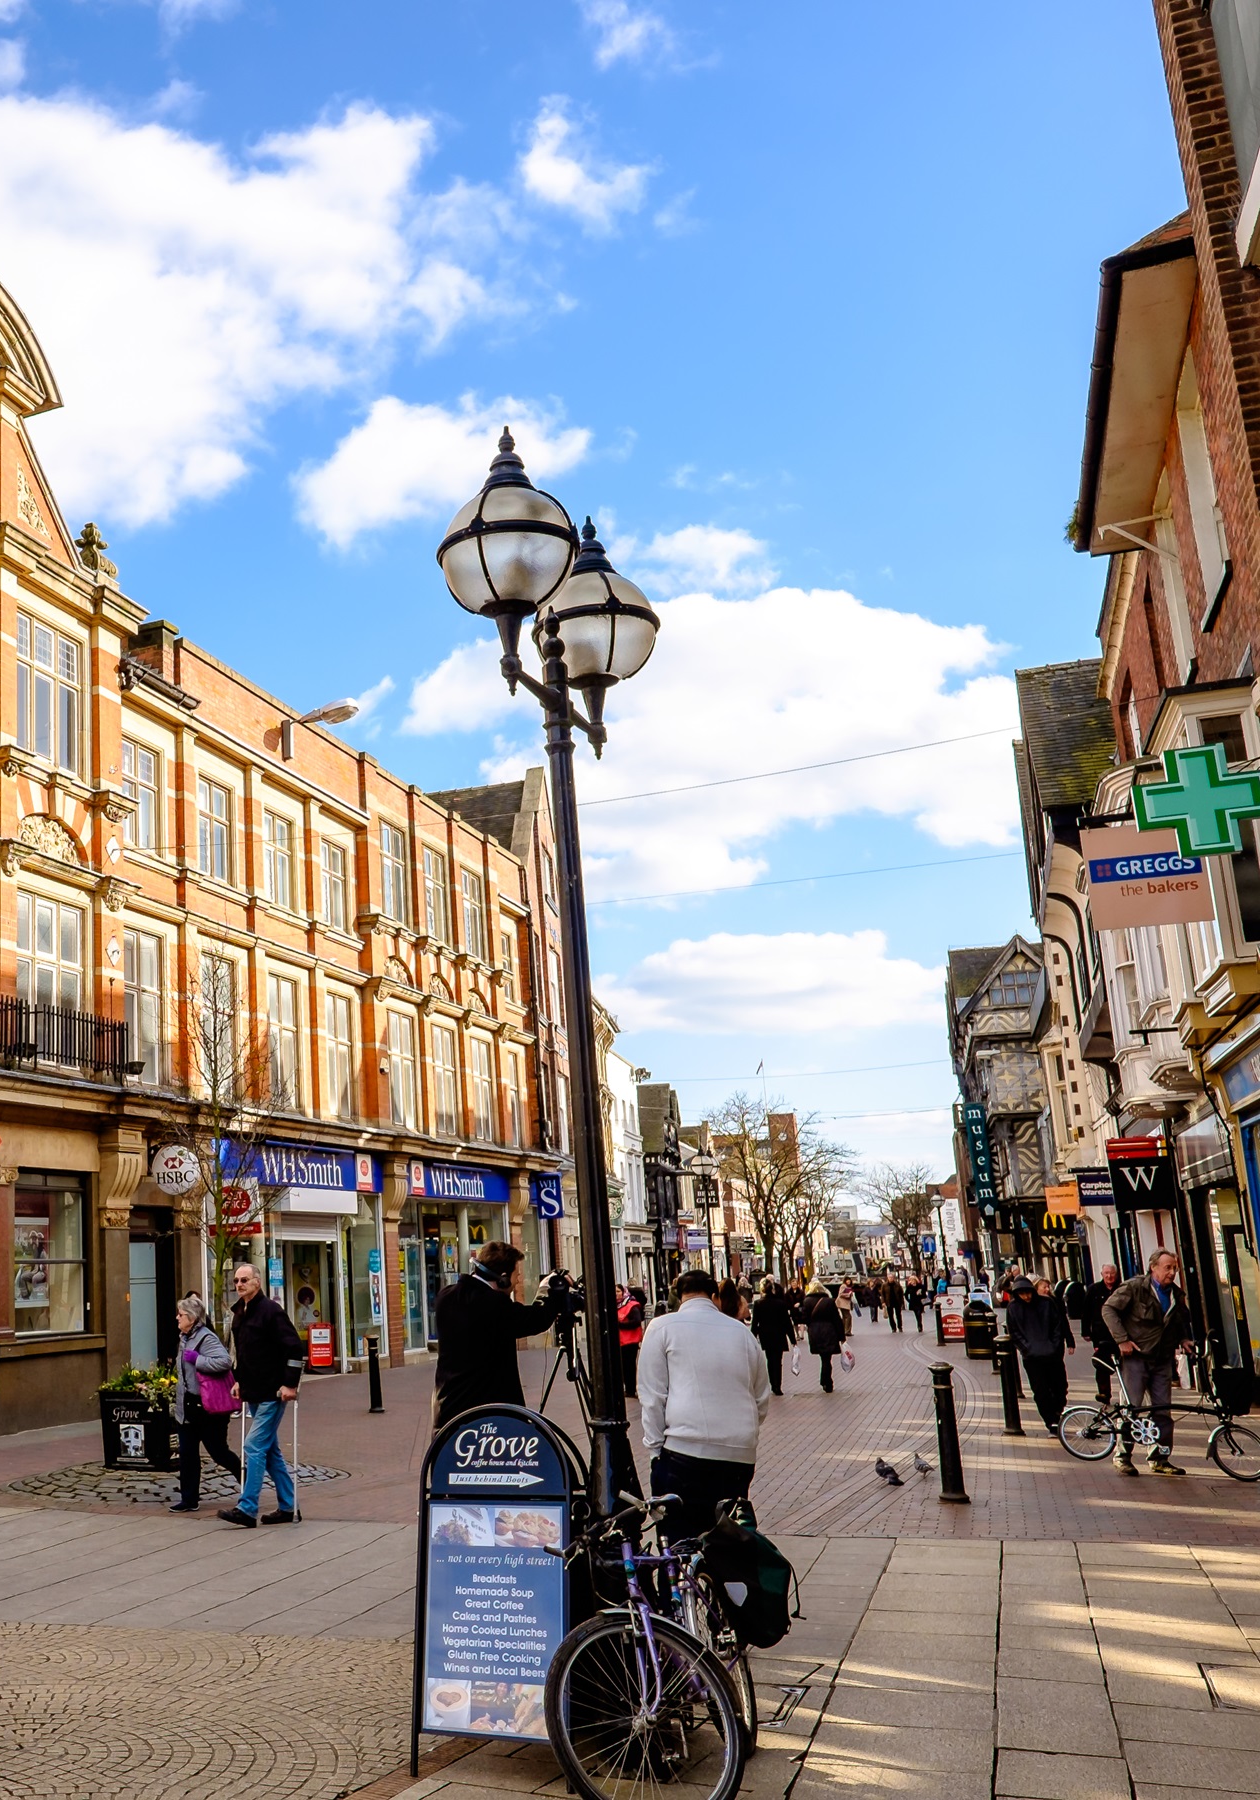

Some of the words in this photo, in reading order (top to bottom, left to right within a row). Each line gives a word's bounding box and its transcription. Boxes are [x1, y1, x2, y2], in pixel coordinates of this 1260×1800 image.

[1116, 856, 1196, 876] GREGGS
[1120, 884, 1143, 897] the
[1147, 880, 1199, 894] bakers
[967, 1109, 994, 1198] museum
[261, 1147, 344, 1187] WHSmith
[156, 1170, 195, 1185] HSBC
[430, 1167, 485, 1198] WHSmith
[539, 1179, 556, 1188] WH
[1119, 1166, 1159, 1191] W
[540, 1188, 560, 1217] S
[112, 1407, 139, 1422] Grove
[480, 1423, 498, 1434] The
[455, 1429, 539, 1467] Grove
[471, 1459, 488, 1467] coffee
[517, 1459, 539, 1467] kitchen
[454, 1475, 472, 1483] Just
[448, 1554, 462, 1563] not
[478, 1557, 502, 1567] every
[503, 1553, 524, 1568] high
[526, 1555, 556, 1566] street!
[472, 1574, 517, 1584] Breakfasts
[455, 1586, 509, 1597] Homemade
[511, 1588, 534, 1599] Soup
[465, 1599, 490, 1609] Great
[493, 1600, 524, 1610] Coffee
[452, 1611, 480, 1621] Cakes
[482, 1613, 501, 1622] and
[503, 1614, 537, 1624] Pastries
[442, 1624, 469, 1633] Home
[471, 1625, 507, 1636] Cooked
[509, 1627, 547, 1638] Lunches
[443, 1636, 492, 1648] Vegetarian
[494, 1639, 546, 1651] Specialities
[447, 1650, 478, 1660] Gluten
[480, 1652, 499, 1661] Free
[502, 1653, 541, 1666] Cooking
[443, 1663, 470, 1673] Wines
[472, 1666, 491, 1674] and
[493, 1666, 518, 1676] Local
[520, 1667, 546, 1678] Beers
